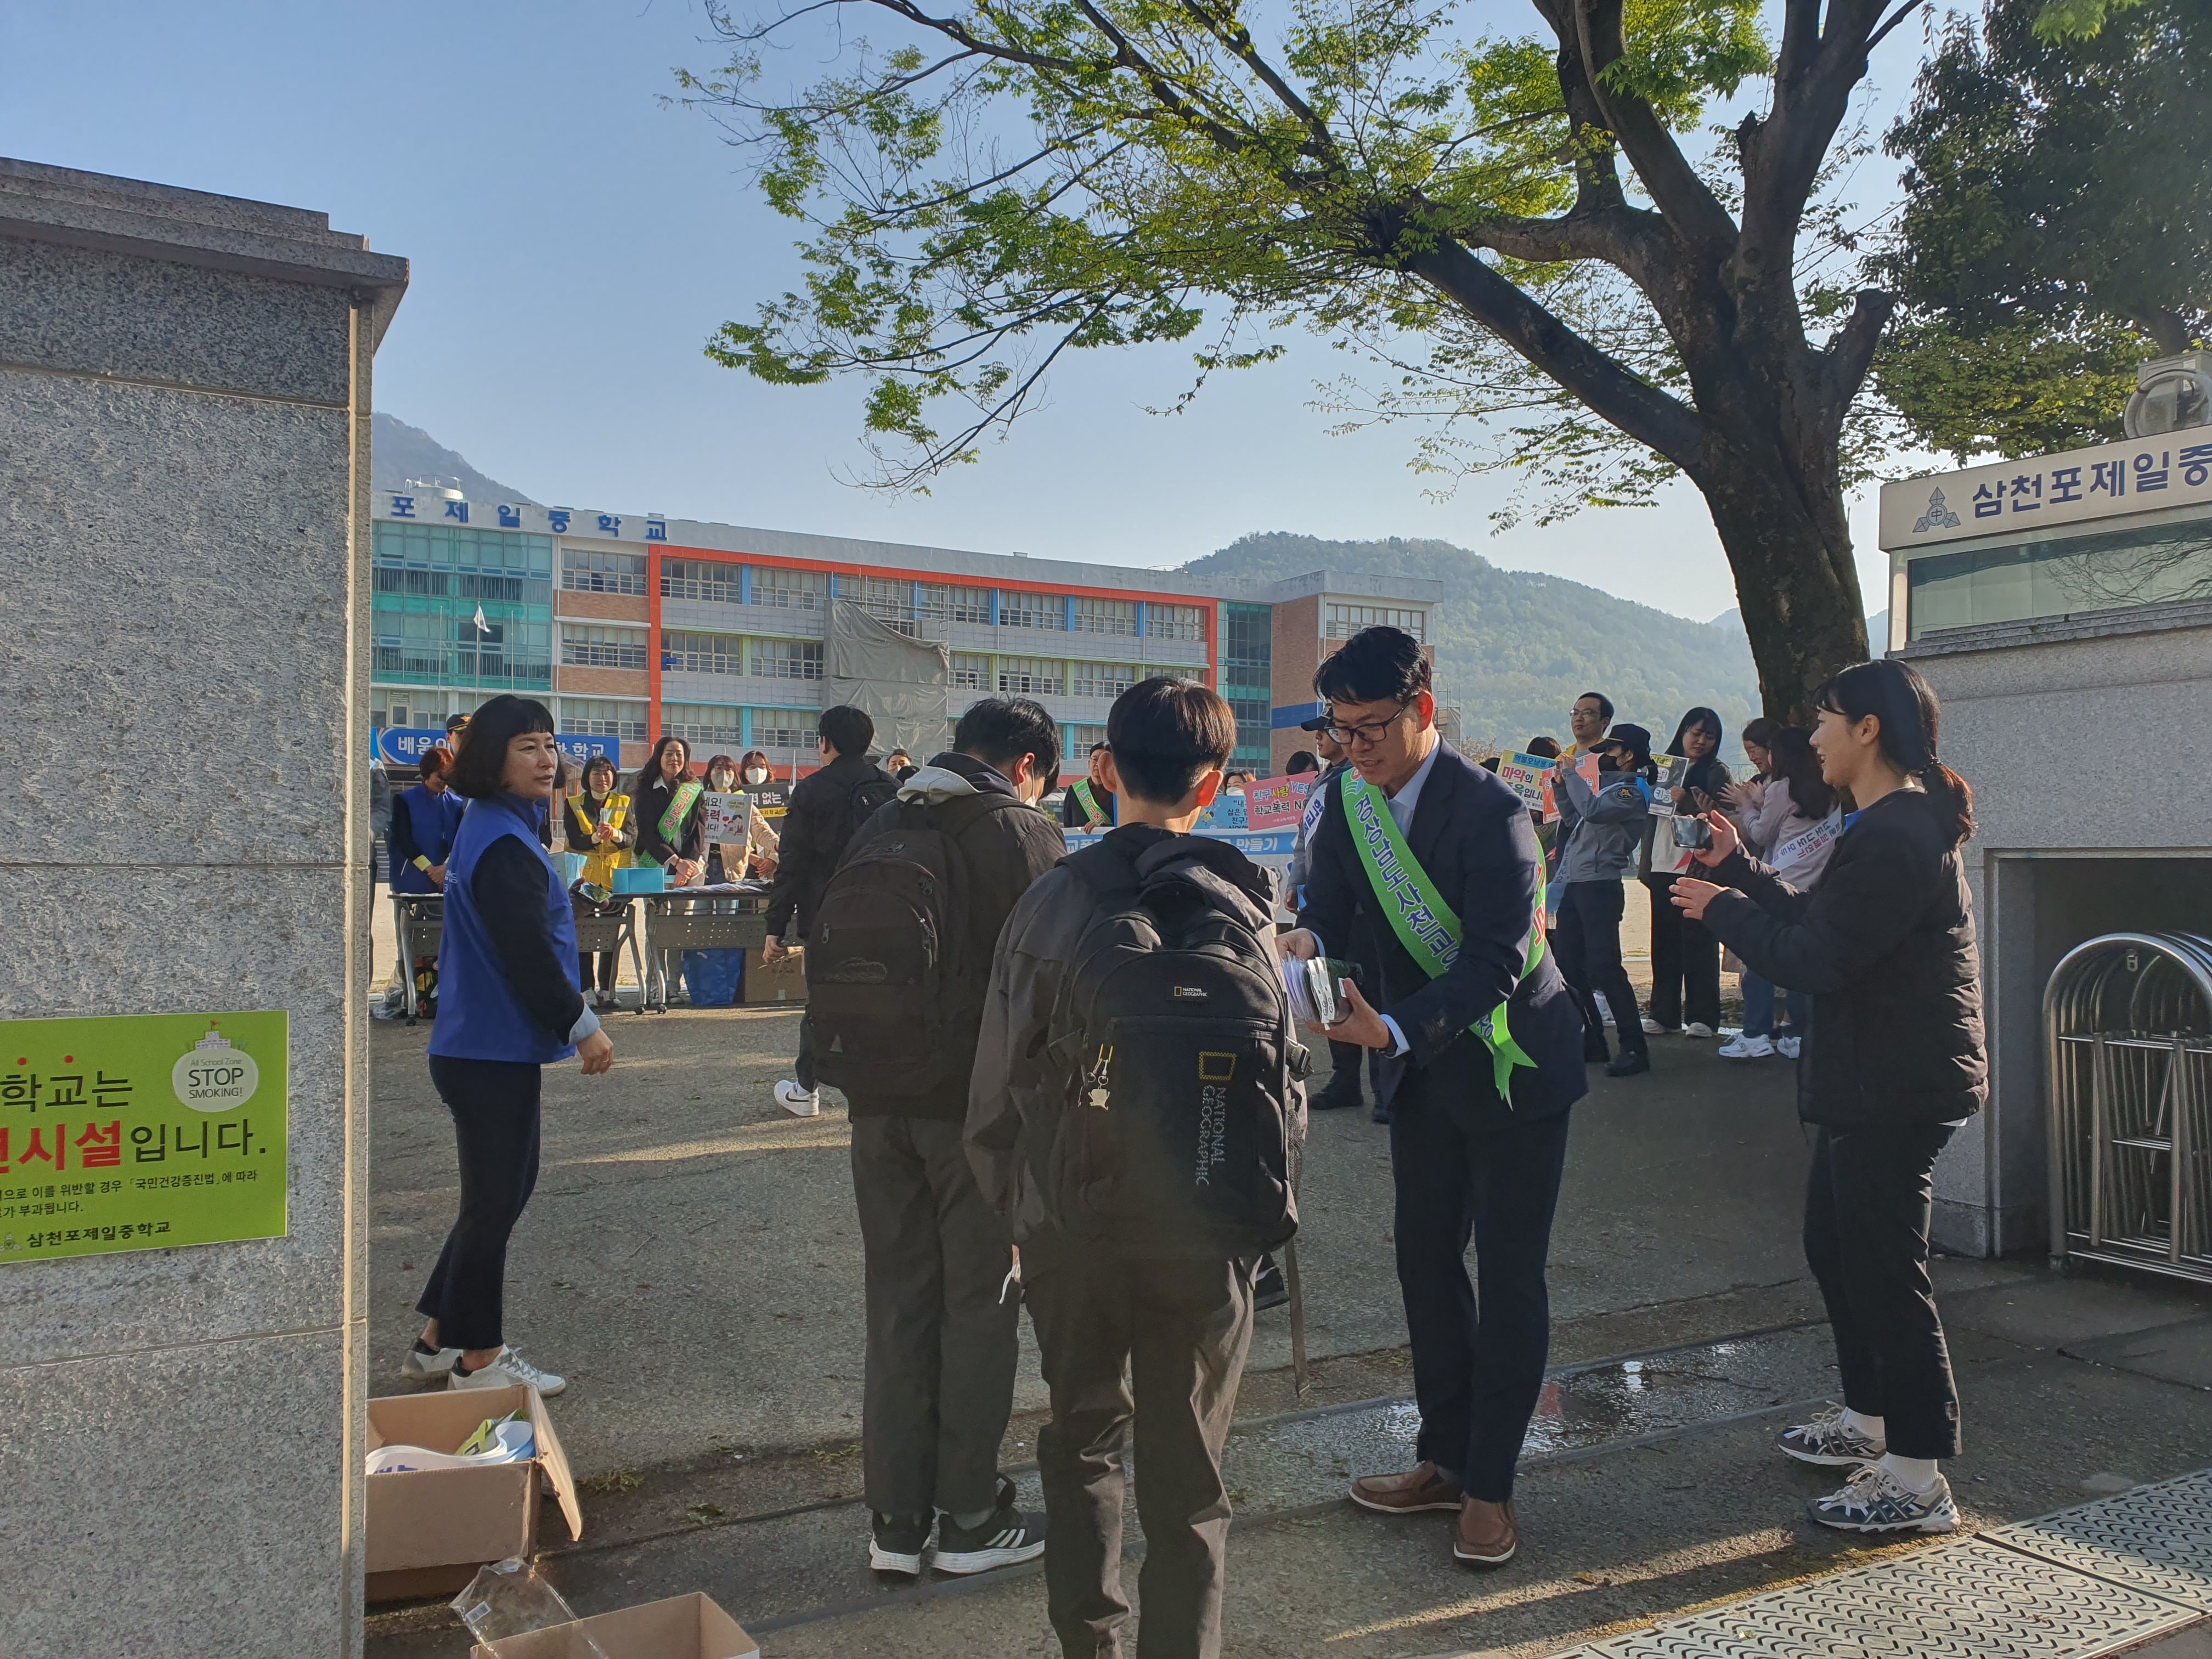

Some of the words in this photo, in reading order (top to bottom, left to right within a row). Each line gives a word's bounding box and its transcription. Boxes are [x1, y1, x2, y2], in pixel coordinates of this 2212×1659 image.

[1972, 444, 2212, 518] 삼천포제일중
[391, 496, 668, 541] 포제일중학교
[572, 742, 605, 760] 학교
[1515, 754, 1547, 768] 약물오남용
[1502, 766, 1534, 783] 마약의
[761, 792, 782, 805] 없는
[1254, 801, 1290, 816] 학교폭력
[1294, 799, 1305, 811] N
[1236, 837, 1278, 852] 만들기
[201, 1058, 224, 1066] School
[188, 1068, 244, 1087] STOP
[0, 1069, 133, 1113] 학교는
[189, 1087, 244, 1099] SMOKING!
[1210, 1086, 1228, 1166] NATIONAL
[1195, 1085, 1216, 1188] GEOGRAPHIC
[32, 1185, 55, 1198] 이를
[60, 1182, 95, 1196] 위반할
[100, 1180, 122, 1193] 경우
[236, 1170, 258, 1182] 따라
[0, 1206, 15, 1218] 가
[19, 1200, 83, 1217] 부과됩니다.
[26, 1221, 171, 1248] 삼천포제일중학교
